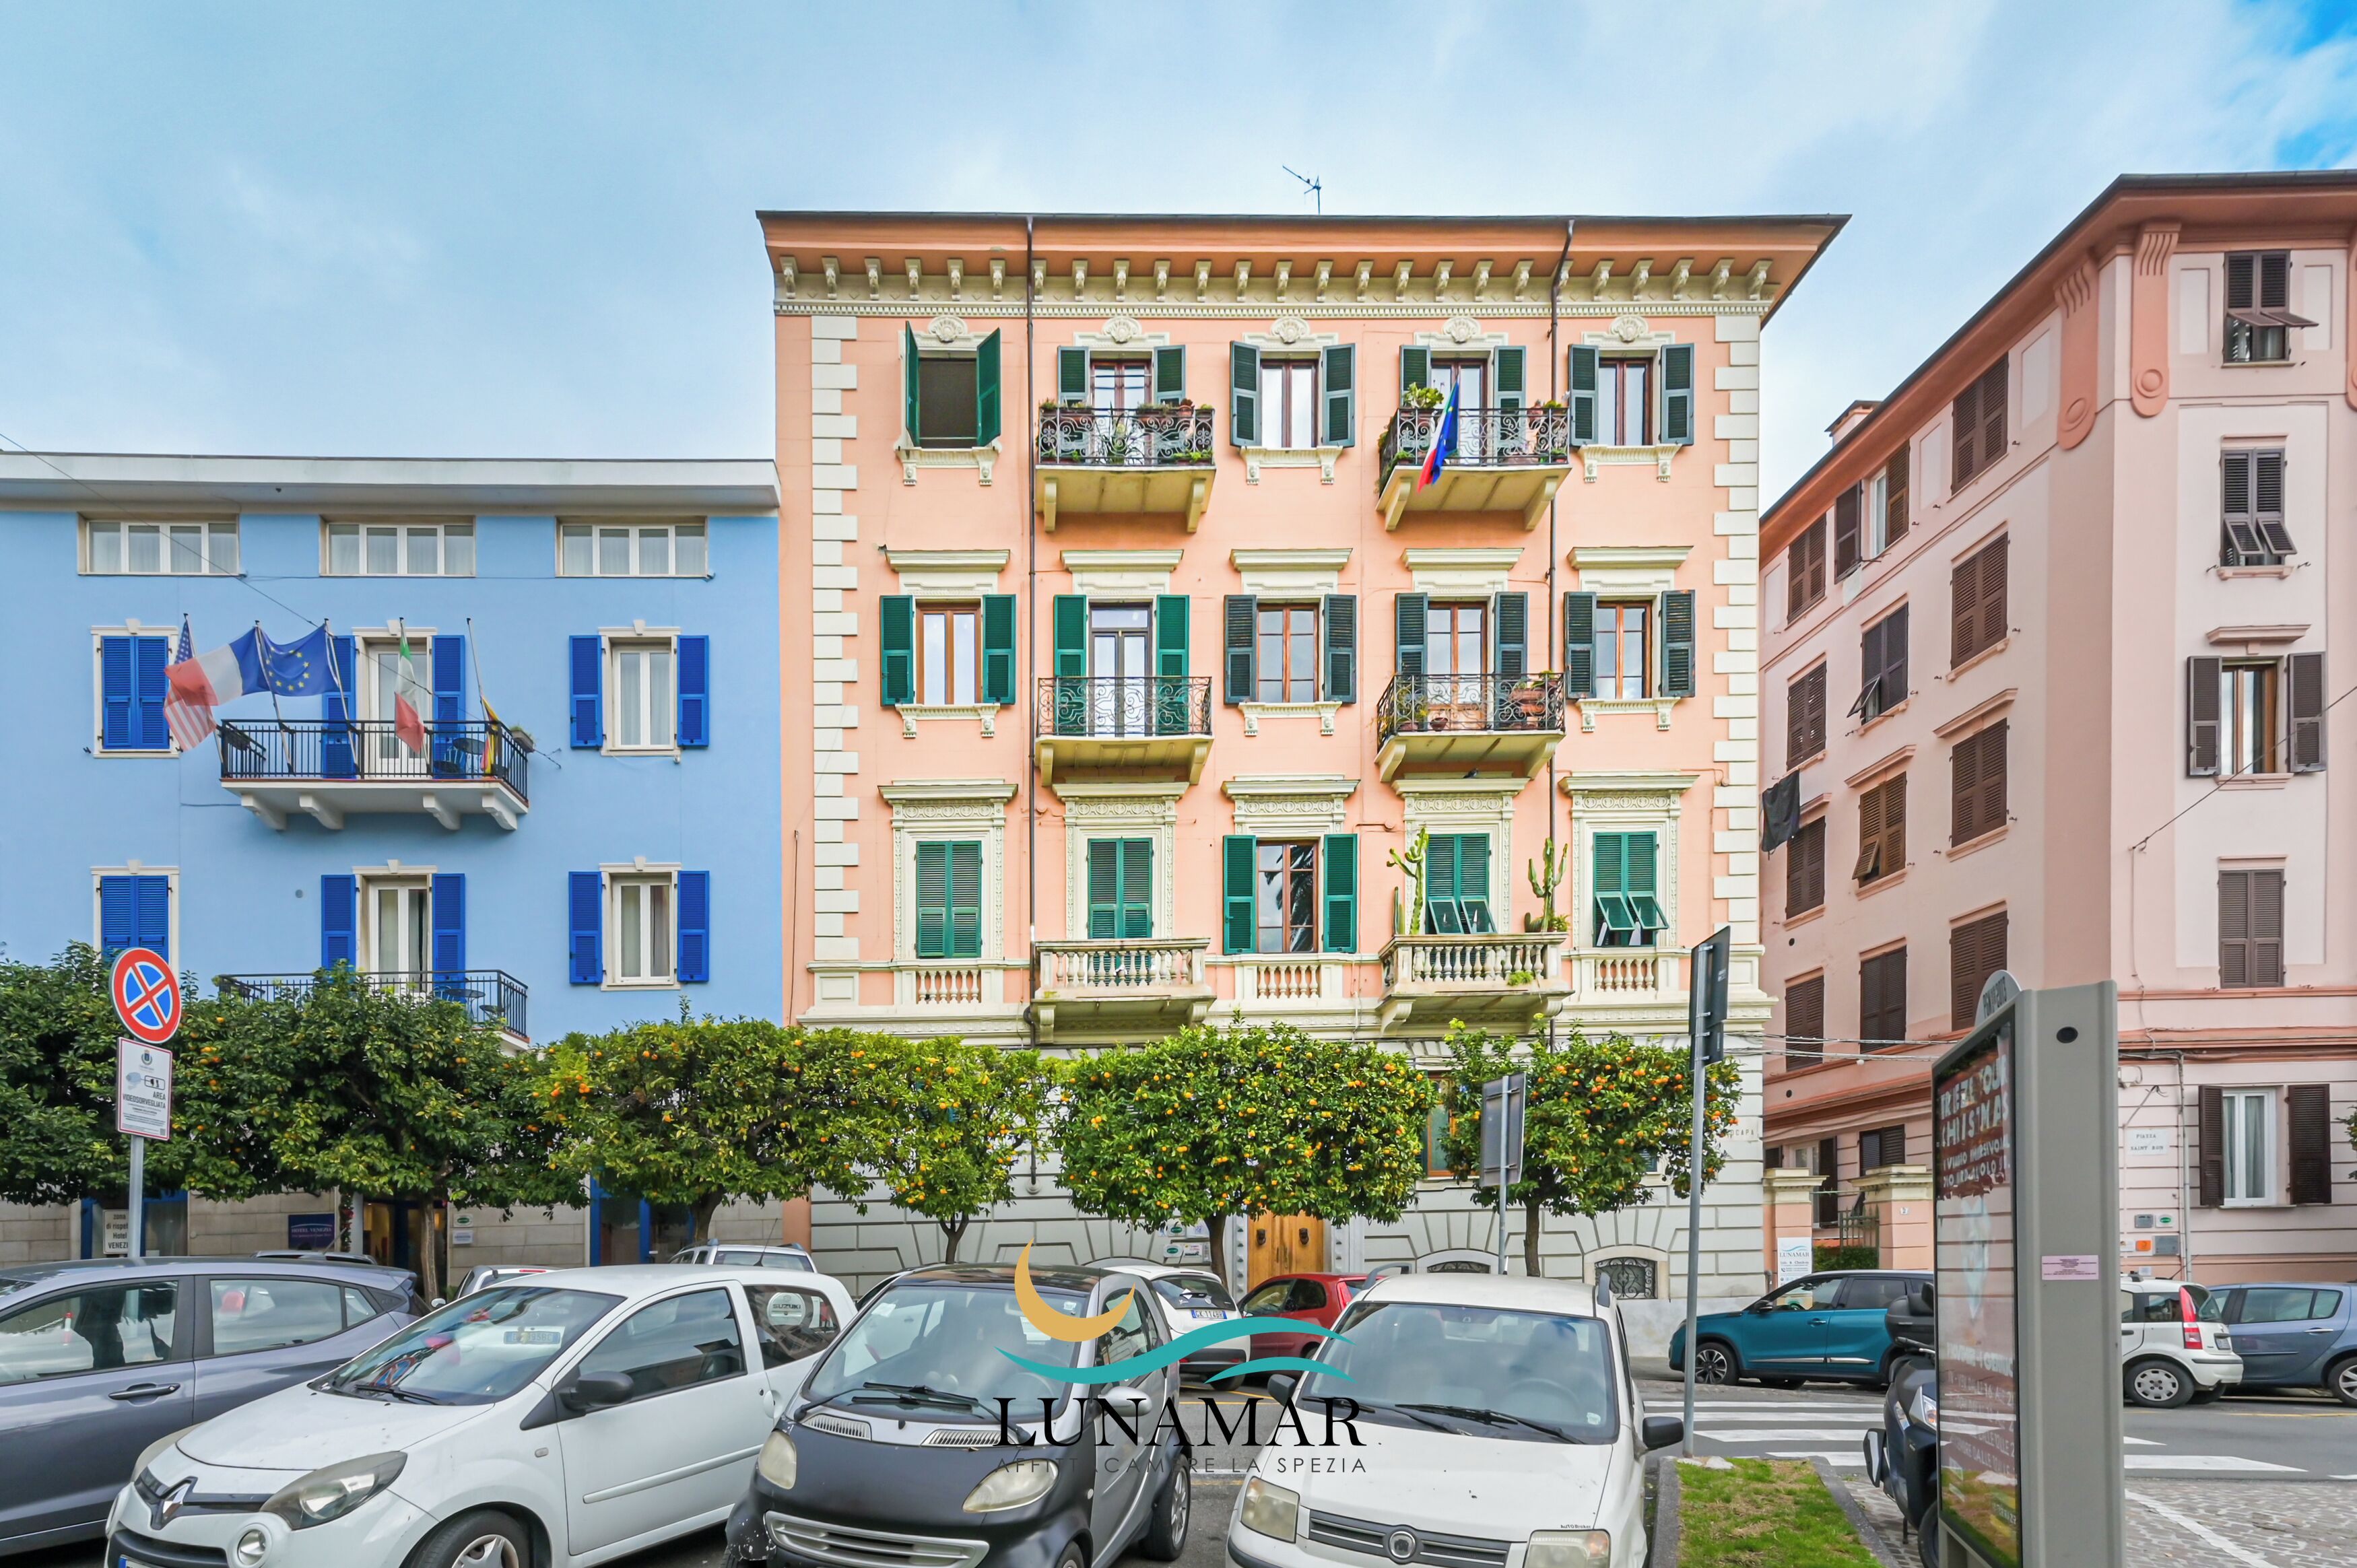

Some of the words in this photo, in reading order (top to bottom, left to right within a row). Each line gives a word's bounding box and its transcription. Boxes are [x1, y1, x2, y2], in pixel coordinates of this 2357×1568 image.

[123, 1093, 166, 1109] VIDEOSORVEGLIATA
[152, 1091, 166, 1101] AREA
[112, 1223, 129, 1231] rispet
